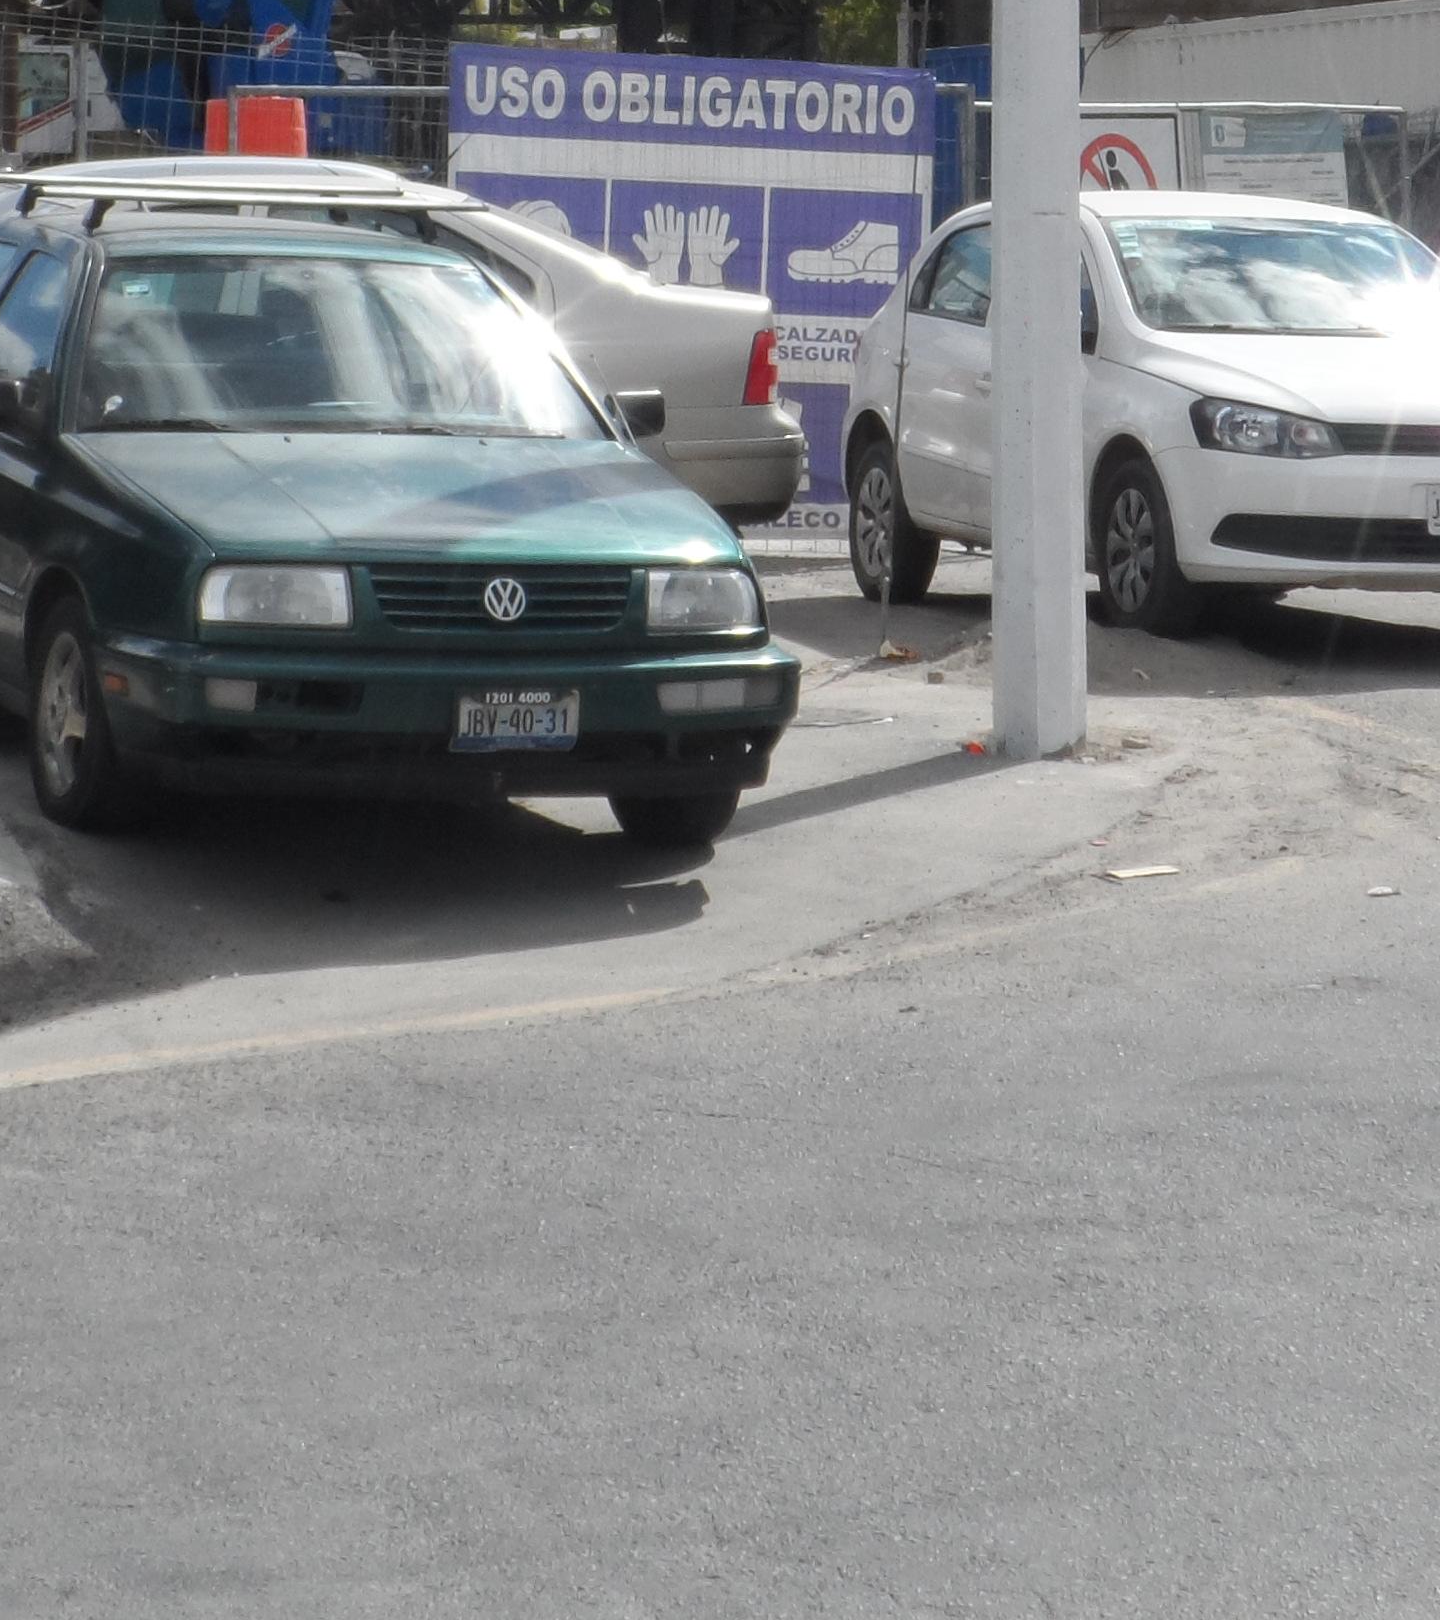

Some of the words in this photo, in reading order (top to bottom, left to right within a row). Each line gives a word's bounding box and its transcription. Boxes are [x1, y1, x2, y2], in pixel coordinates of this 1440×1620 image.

[465, 64, 565, 120] USO
[582, 70, 916, 137] OBLIGATORIO
[775, 326, 859, 344] CALZAD
[518, 692, 551, 704] 4000
[461, 708, 569, 736] JBV-40-31
